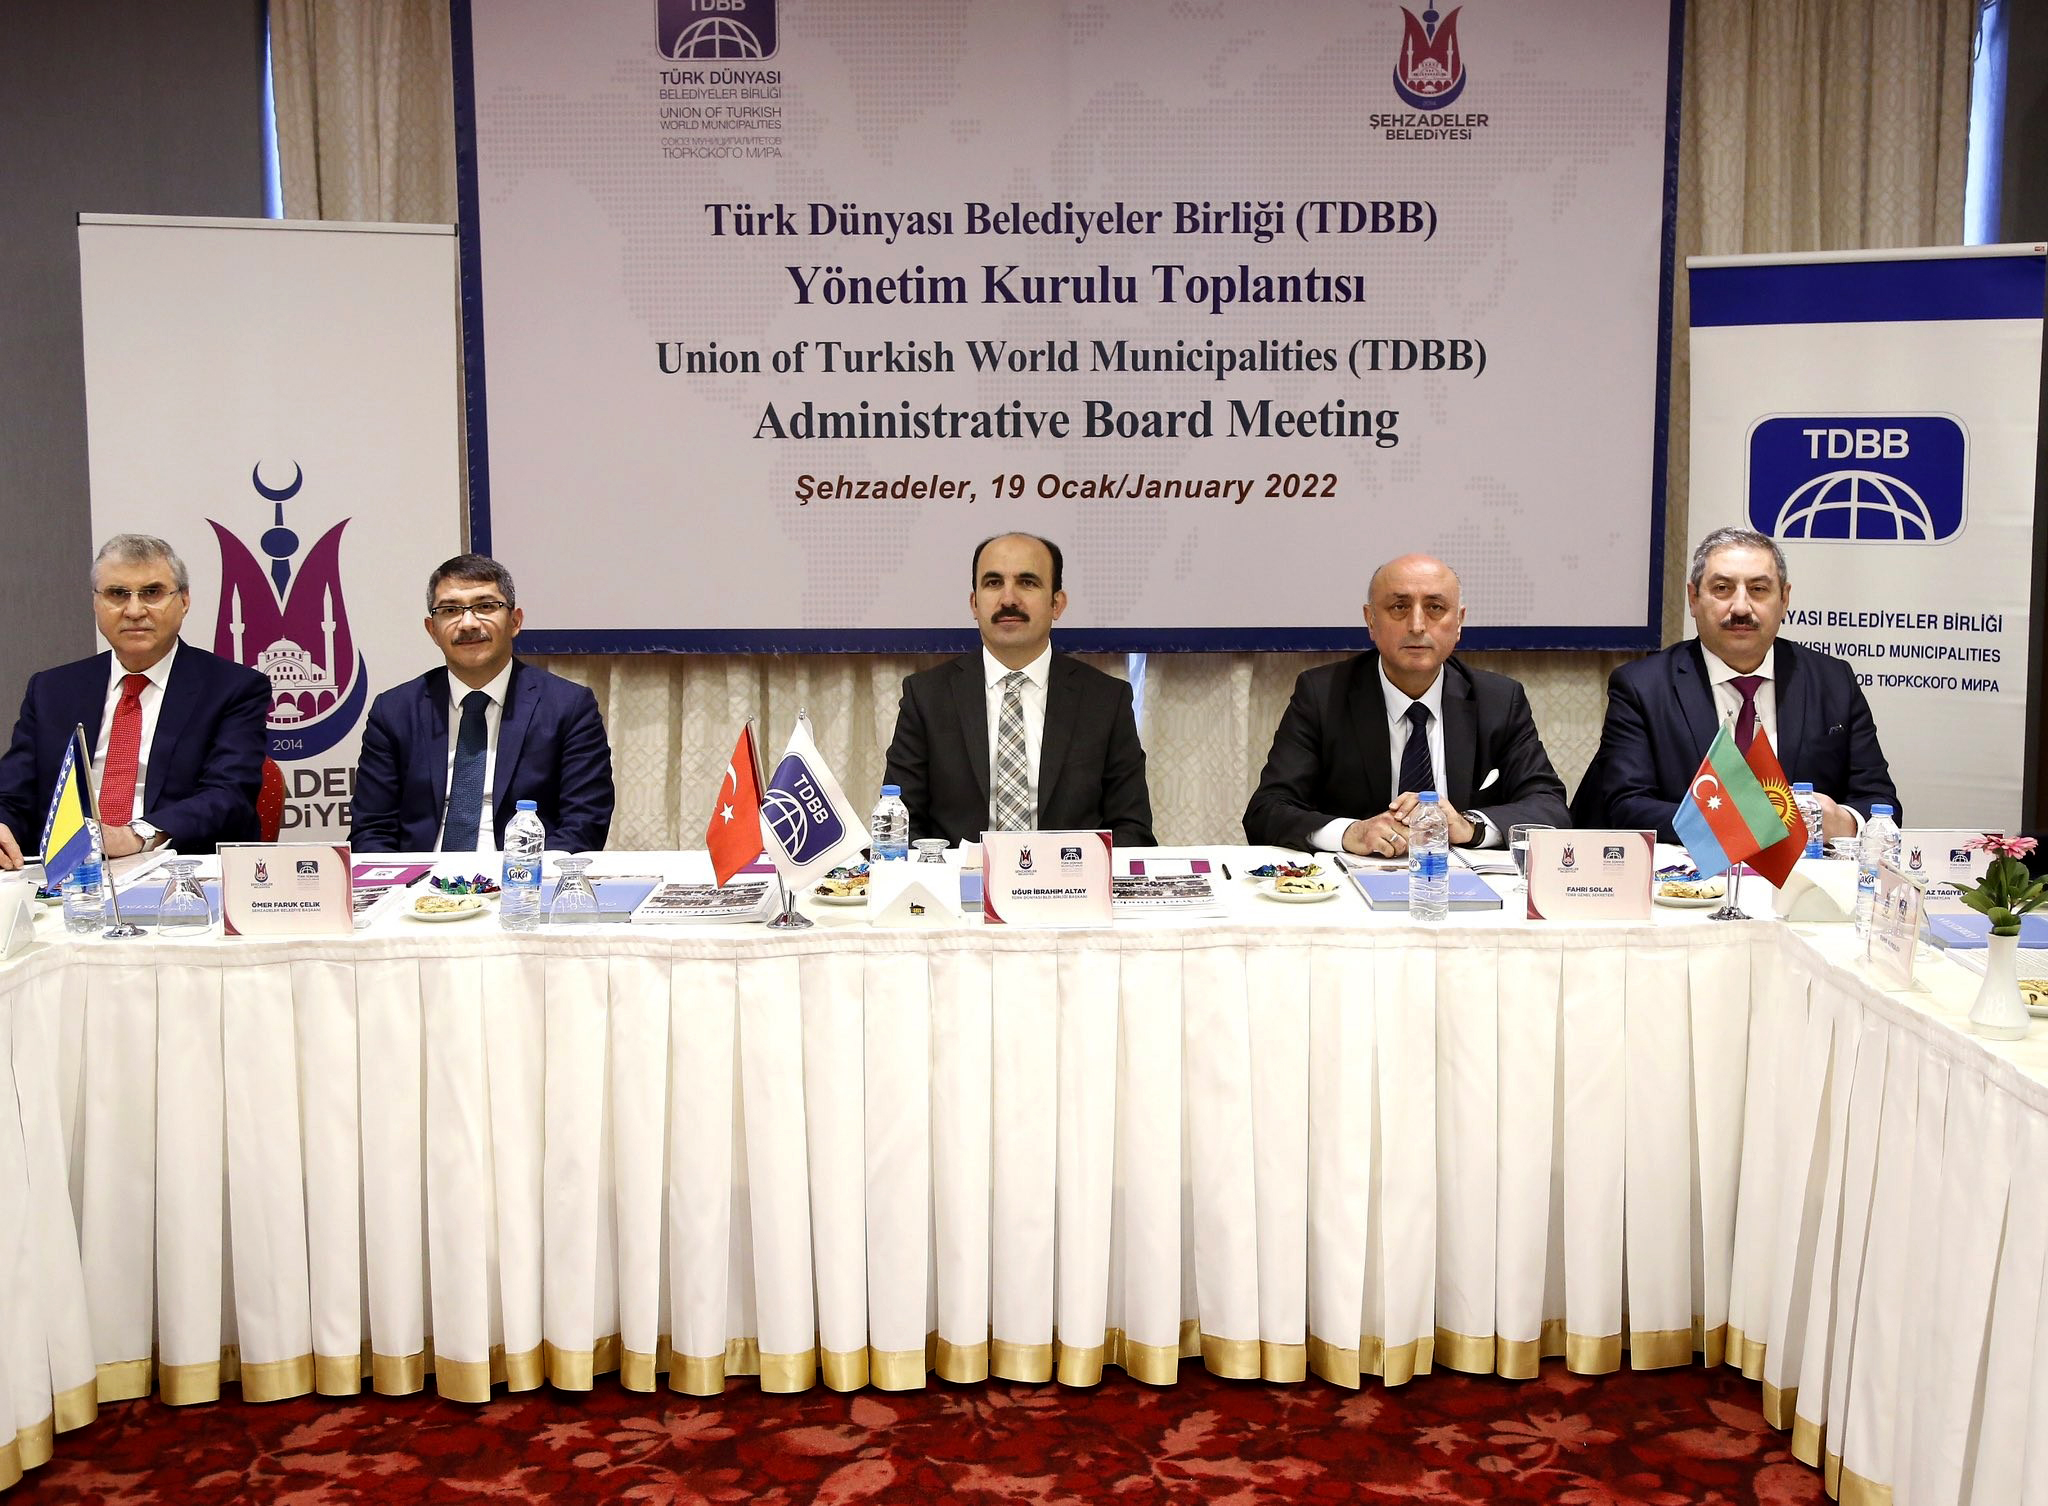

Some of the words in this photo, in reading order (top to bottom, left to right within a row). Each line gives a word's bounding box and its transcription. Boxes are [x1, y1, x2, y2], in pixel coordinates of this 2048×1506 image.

[660, 68, 704, 85] TÜRK
[710, 67, 781, 85] DÜNYASI
[660, 88, 738, 100] BELEDİYELER
[741, 87, 782, 99] BİRLİĞİ
[660, 106, 701, 119] UNION
[705, 106, 722, 119] OF
[726, 106, 782, 118] TURKISH
[1369, 113, 1489, 130] ŞEHZADELER
[660, 121, 699, 130] WORLD
[702, 120, 782, 130] MUNICIPALITIES
[746, 146, 783, 159] МИРА
[705, 203, 799, 236] Türk
[808, 203, 953, 244] Dünyası
[965, 201, 1162, 245] Belediyeler
[1173, 201, 1286, 243] Birliği
[1296, 200, 1438, 242] (TDBB)
[785, 265, 968, 305] Yönetim
[982, 265, 1138, 304] Kurulu
[1152, 265, 1366, 315] Toplantısı
[656, 341, 761, 374] Union
[772, 341, 809, 373] of
[815, 340, 955, 373] Turkish
[966, 339, 1079, 373] World
[1090, 340, 1337, 380] Municipalities
[1348, 339, 1487, 379] (TDBB)
[753, 400, 1070, 439] Administrative
[1082, 400, 1213, 438] Board
[1226, 399, 1400, 448] Meeting
[1803, 428, 1910, 459] TDBB
[795, 475, 977, 505] Şehzadeler,
[991, 475, 1025, 499] 19
[1037, 473, 1254, 504] Ocak/January
[1265, 474, 1337, 498] 2022
[1782, 610, 1822, 626] YASI
[1827, 610, 1938, 629] BELEDİYELER
[1943, 612, 2002, 632] BİRLİĞİ
[1835, 642, 1885, 657] WORLD
[1889, 644, 2001, 662] MUNICIPALITIES
[1877, 673, 1958, 689] ТЮРКСКОГО
[1961, 678, 2000, 692] МИРА
[273, 739, 303, 751] 2014
[793, 773, 829, 824] TDBB
[1859, 873, 1874, 884] aka
